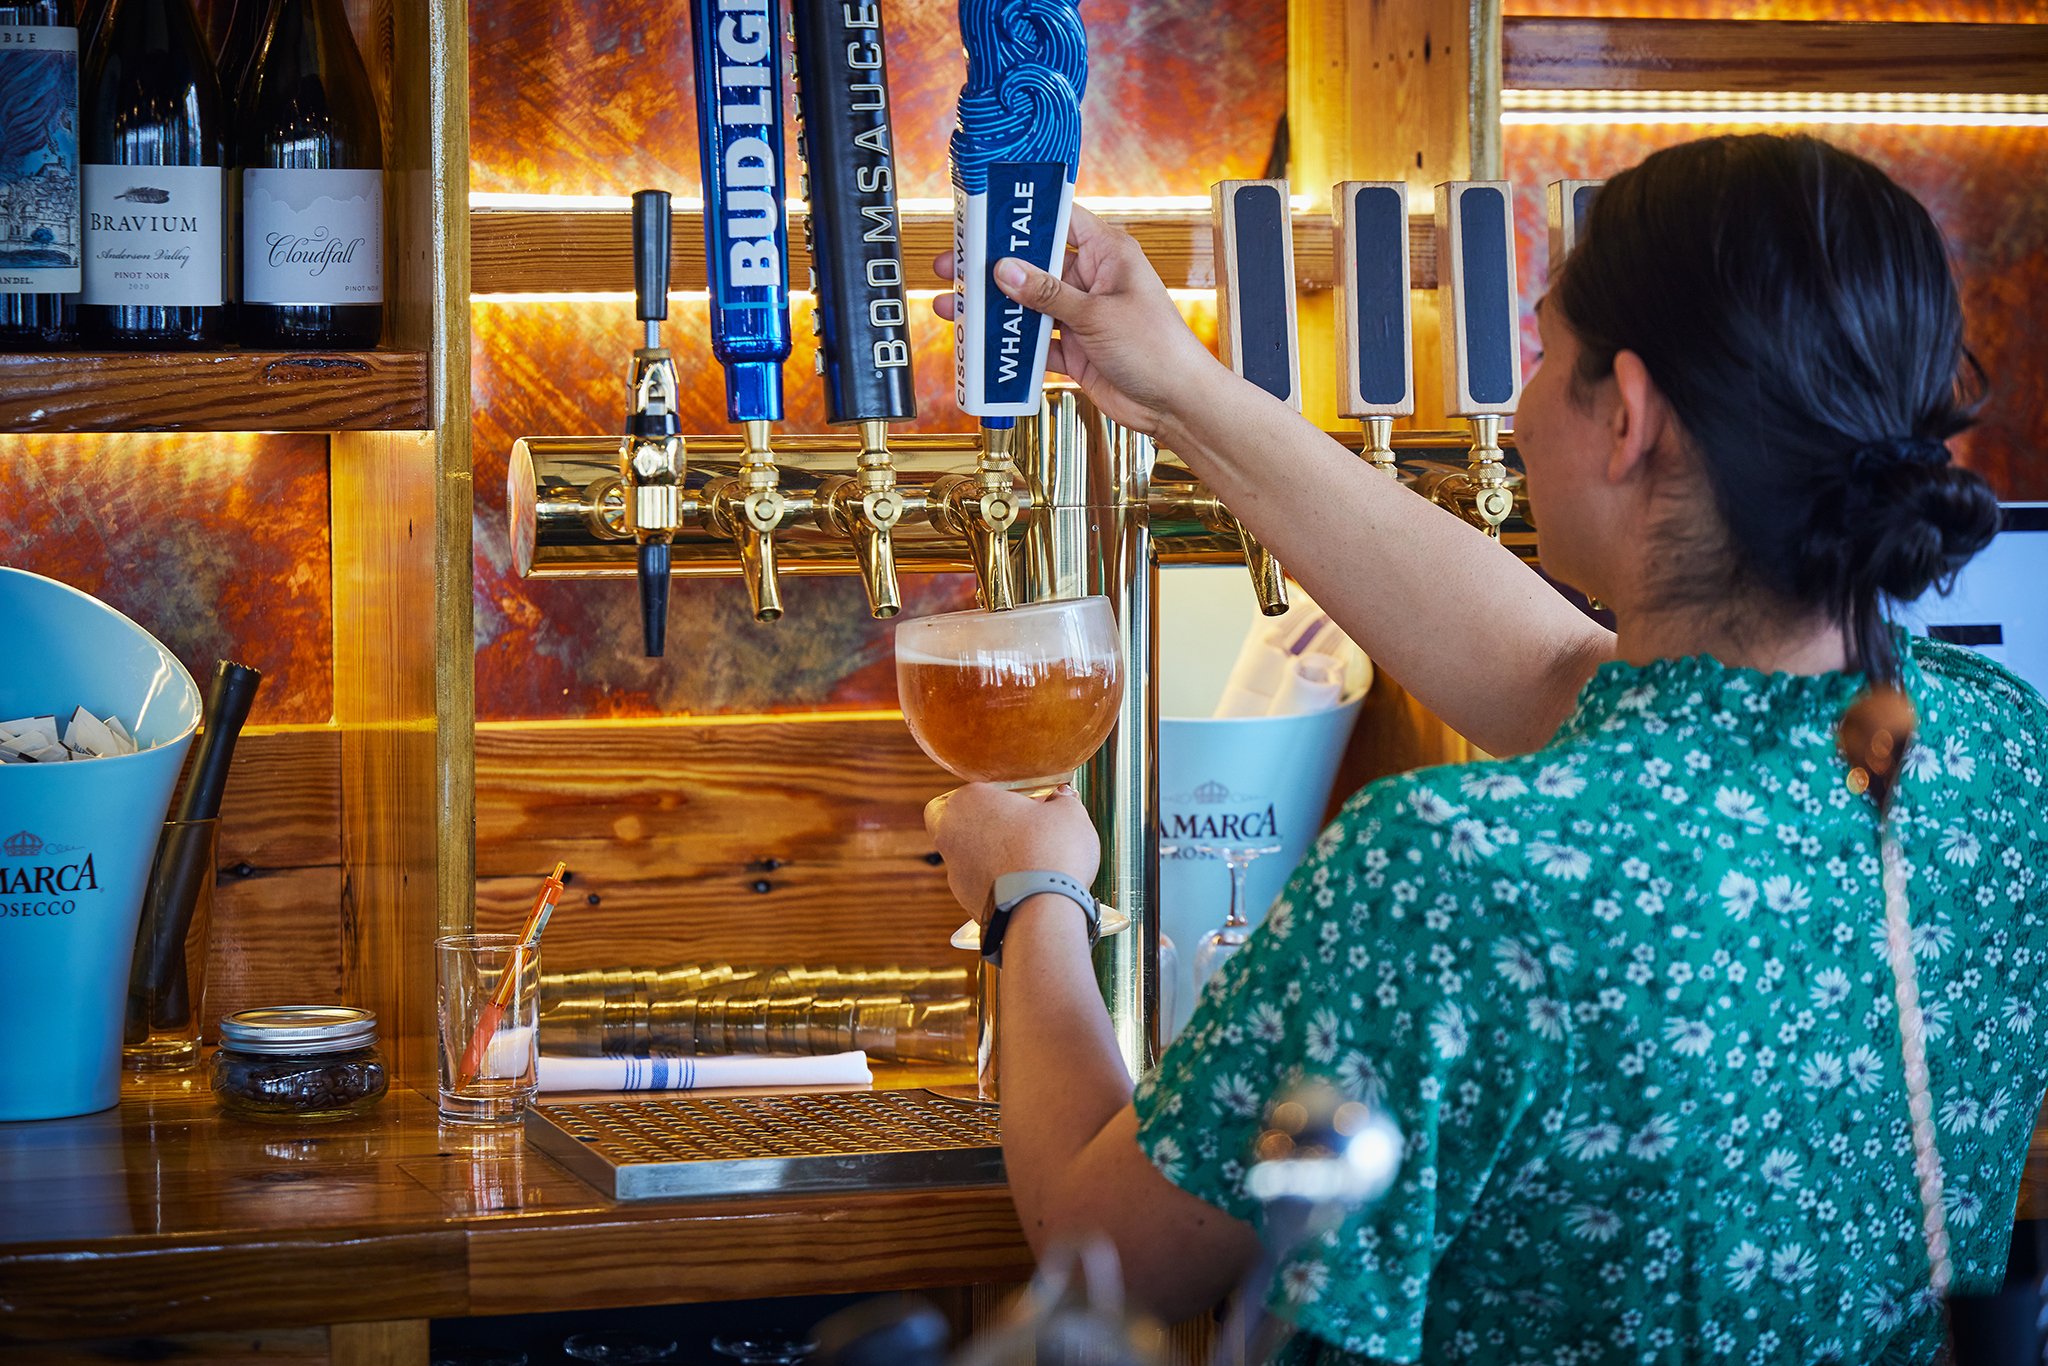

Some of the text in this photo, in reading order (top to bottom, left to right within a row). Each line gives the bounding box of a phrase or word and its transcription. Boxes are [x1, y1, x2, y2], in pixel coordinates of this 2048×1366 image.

[3, 32, 36, 43] BLE
[725, 136, 781, 287] BUD
[844, 4, 908, 368] BOOMSAUCE
[90, 212, 198, 232] BRAVIUM
[96, 246, 191, 269] Anderson Valley
[114, 271, 171, 280] PINOT NOIR
[266, 226, 366, 277] Cloudfall
[955, 193, 966, 406] CISCO BREWERS
[998, 181, 1035, 383] WHAL TALE
